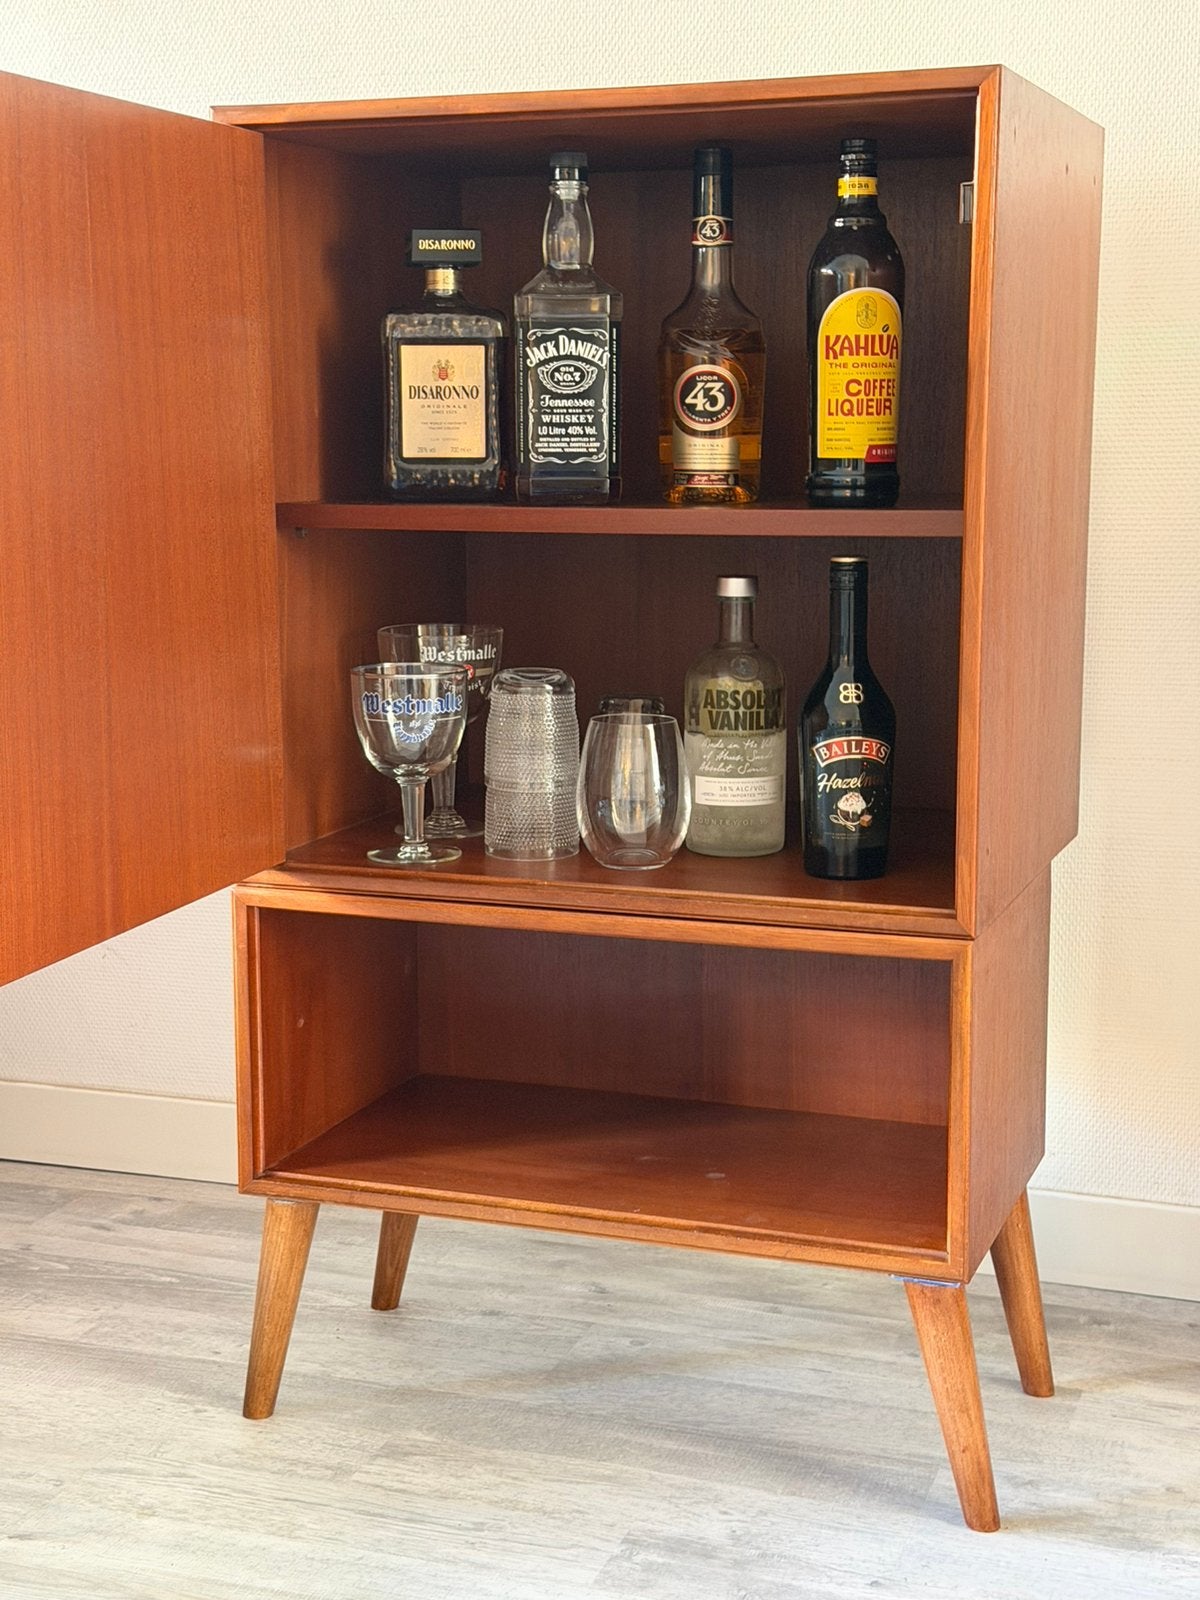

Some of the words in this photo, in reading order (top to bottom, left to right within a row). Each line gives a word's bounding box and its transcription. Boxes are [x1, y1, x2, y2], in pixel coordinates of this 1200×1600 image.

[700, 222, 720, 237] 43
[418, 239, 476, 250] DISARONNO
[525, 340, 559, 368] JACK
[408, 385, 480, 401] DISARONNO
[845, 378, 896, 397] COFFEE
[540, 394, 596, 407] Tennessee
[684, 382, 726, 412] 43
[827, 399, 893, 417] LIQUEUR
[541, 414, 595, 423] WHISKEY
[549, 426, 566, 435] Litre
[567, 426, 584, 435] 40%
[421, 643, 497, 662] Westmalle
[362, 691, 463, 715] Westmalle
[819, 741, 889, 761] BAILEYS
